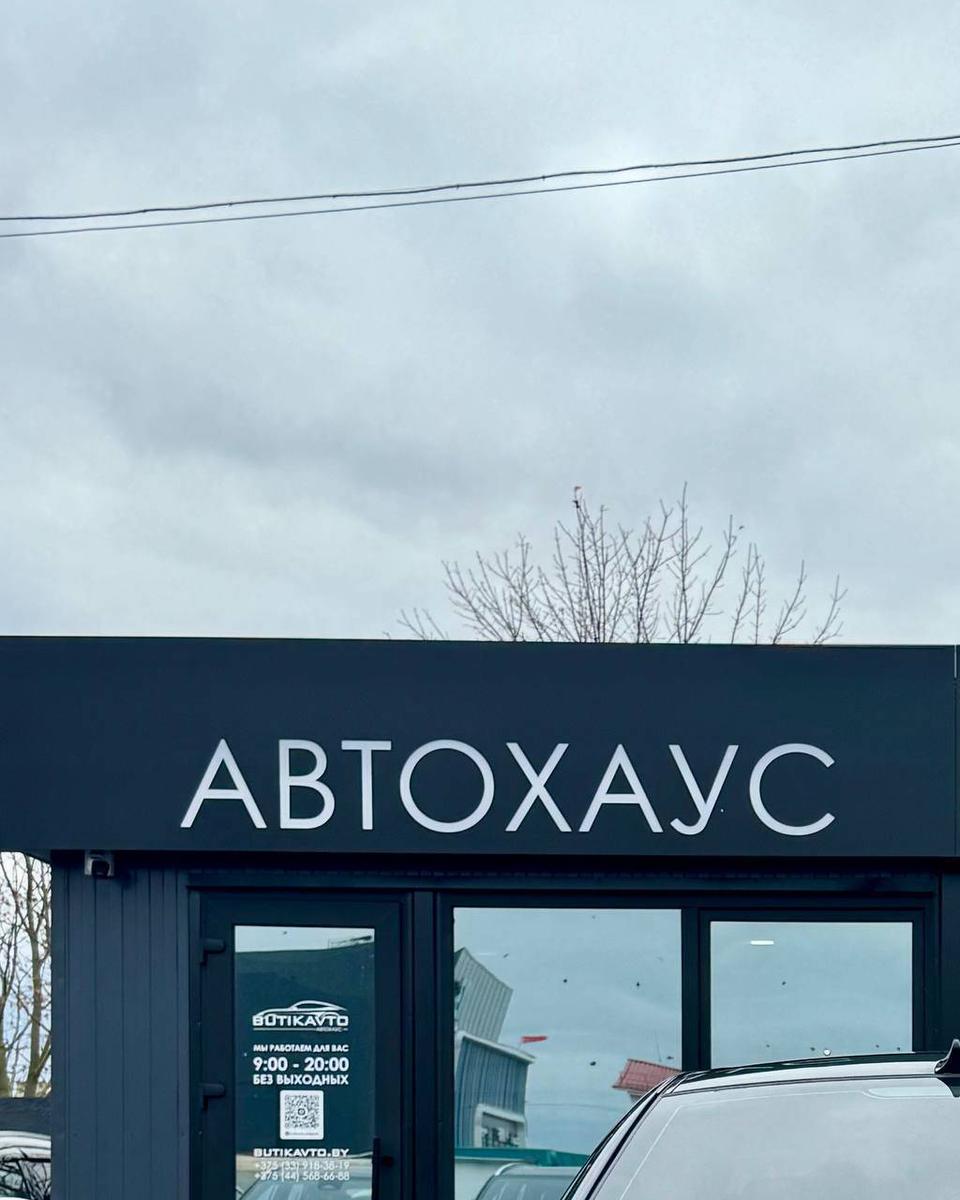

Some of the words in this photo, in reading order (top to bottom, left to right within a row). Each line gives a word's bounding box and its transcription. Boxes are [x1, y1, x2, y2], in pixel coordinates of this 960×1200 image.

[180, 738, 836, 837] АВТОХАУС
[252, 1014, 349, 1027] BUTIKAVTO
[253, 1044, 269, 1052] МЫ
[269, 1044, 312, 1052] РАБОТАЕМ
[313, 1044, 330, 1053] ДЛЯ
[331, 1044, 349, 1052] ВАС
[253, 1057, 288, 1072] 9:00
[304, 1056, 350, 1072] 20:00
[253, 1074, 273, 1085] БЕЗ
[276, 1073, 349, 1086] ВЫХОДНЫХ
[253, 1148, 350, 1157] BUTIKAVTO.BY
[255, 1161, 278, 1170] +375
[281, 1160, 300, 1172] (33)
[302, 1160, 350, 1171] 918-38-19
[254, 1171, 278, 1180] +375
[281, 1171, 300, 1182] (44)
[302, 1171, 350, 1181] 568-66-88
